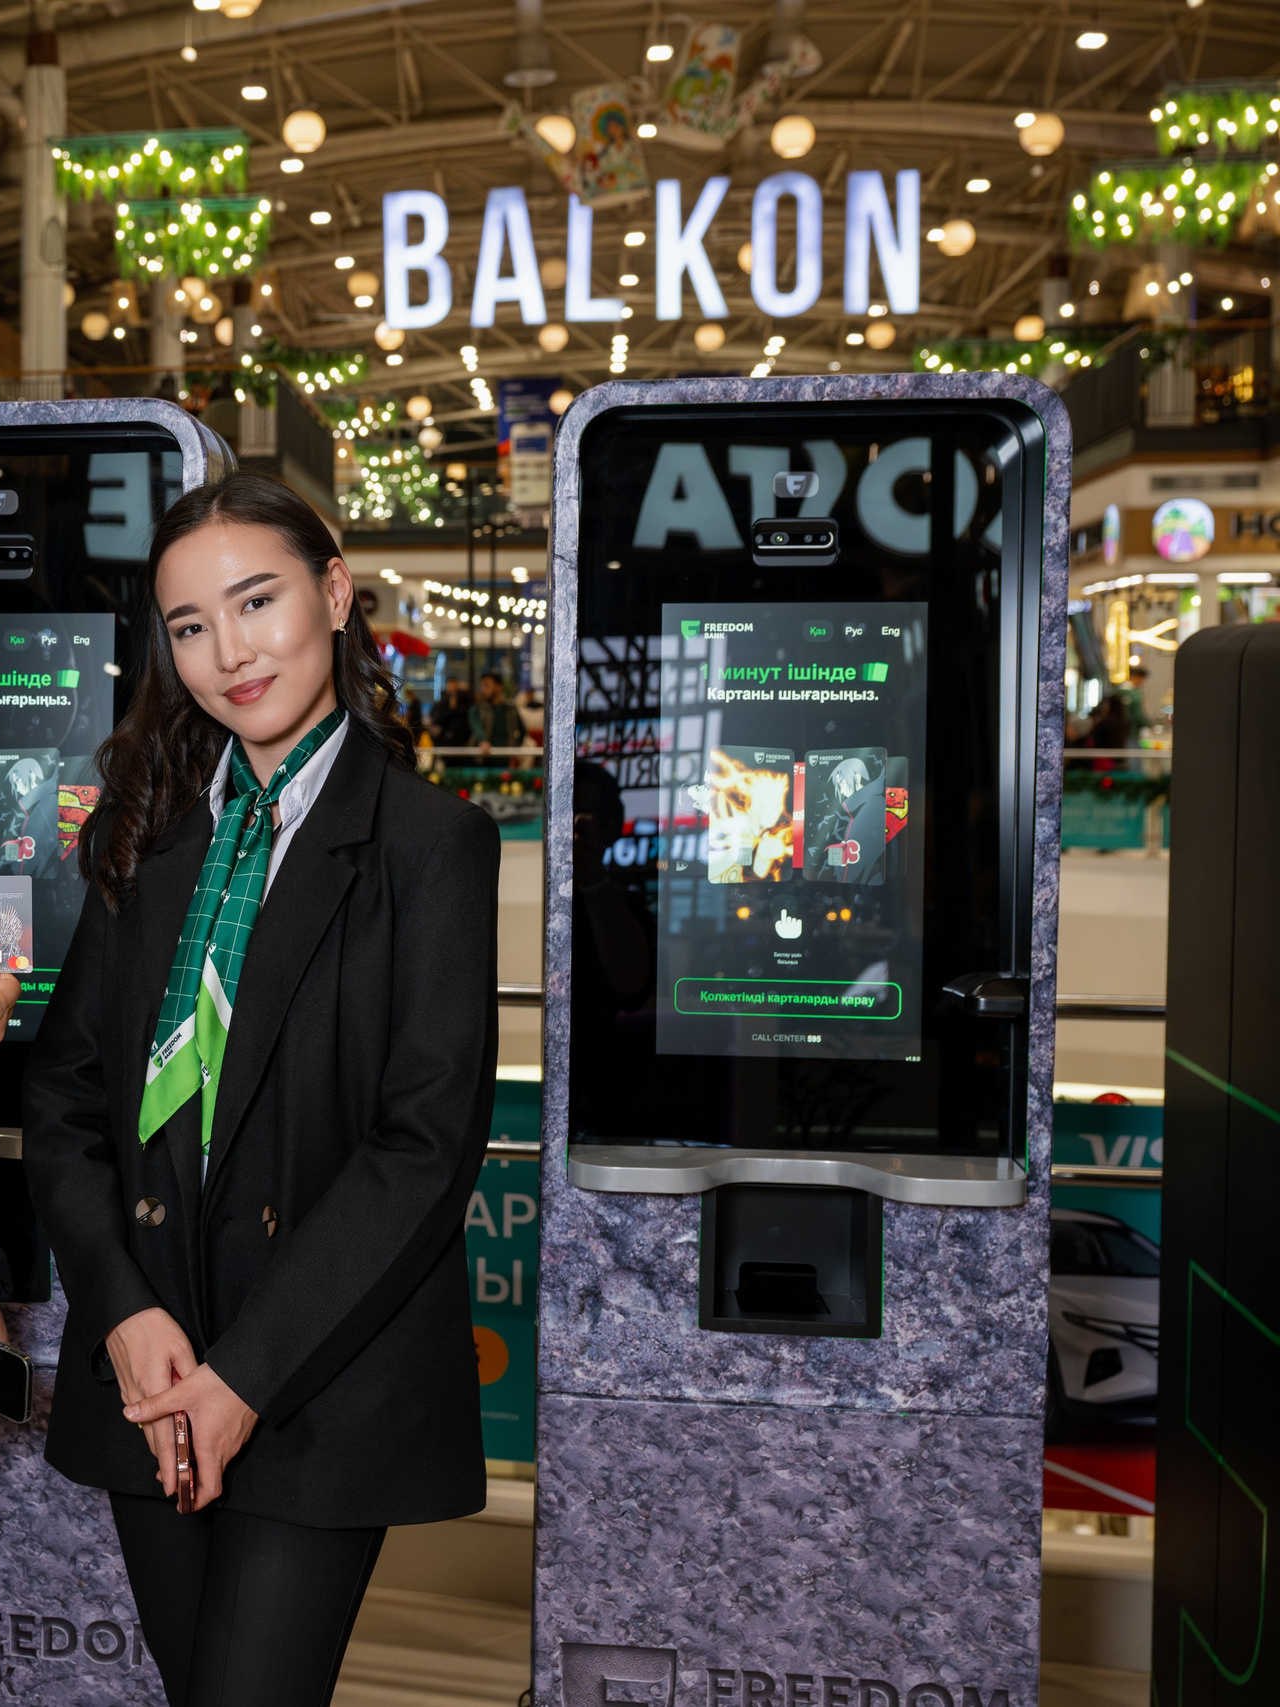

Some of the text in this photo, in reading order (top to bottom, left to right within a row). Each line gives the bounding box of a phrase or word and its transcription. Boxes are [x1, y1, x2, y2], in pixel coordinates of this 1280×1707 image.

[382, 168, 921, 330] BALKON
[704, 622, 754, 633] FREEDOM
[809, 625, 901, 639] Қаз Рус Eng
[10, 635, 90, 647] Қаз Рус Eng
[704, 632, 725, 640] BANK
[700, 663, 857, 684] 1 минут ішінде
[707, 687, 879, 703] Картаны шығарыңыз.
[700, 990, 876, 1008] Қолжетімді карталарды қарау
[7, 1018, 22, 1027] 595
[161, 1032, 182, 1056] FREEDOM
[751, 1033, 822, 1044] CALL CENTER 595
